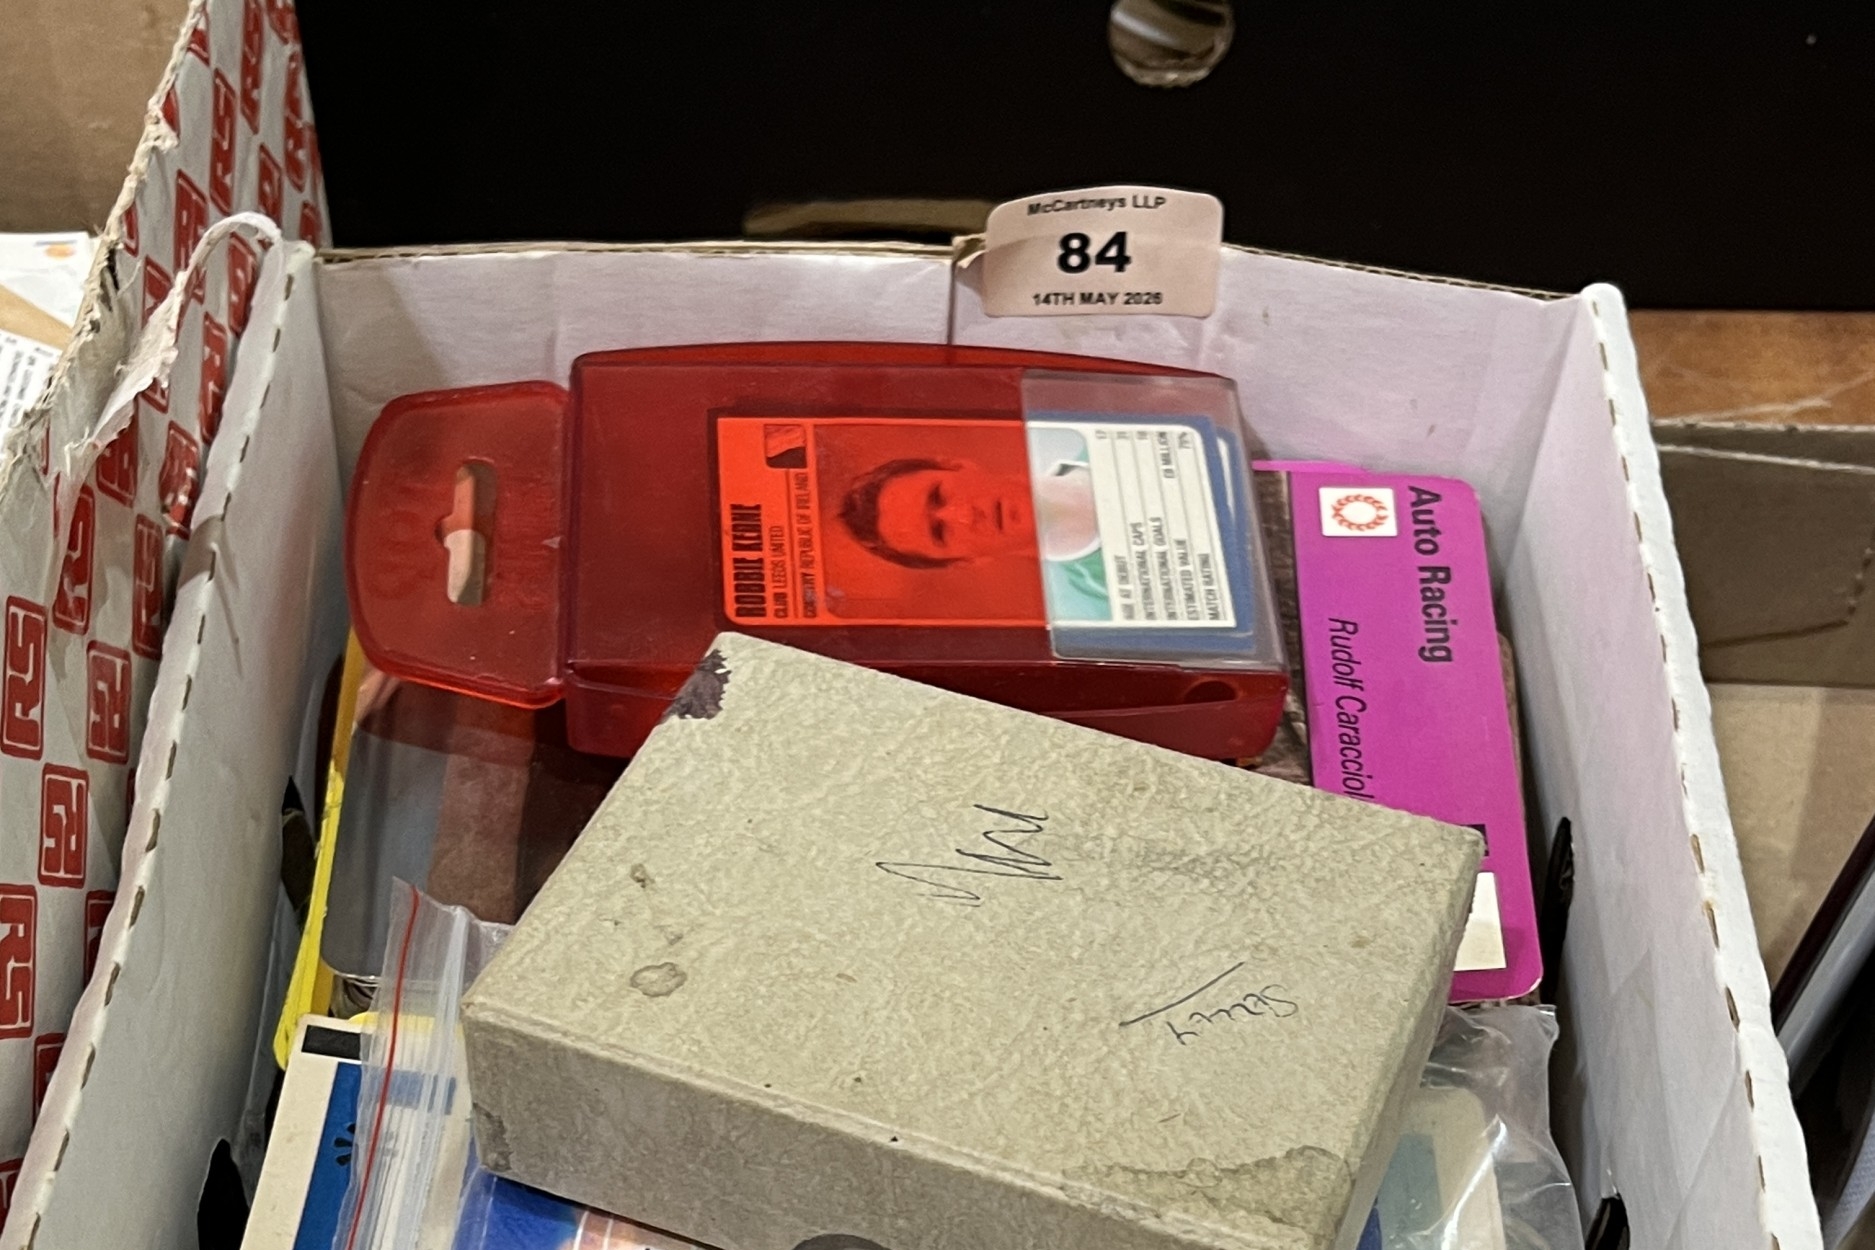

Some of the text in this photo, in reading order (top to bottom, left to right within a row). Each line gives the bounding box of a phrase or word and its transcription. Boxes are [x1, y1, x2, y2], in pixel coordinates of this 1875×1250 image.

[1026, 195, 1167, 215] McCartneys LLP
[1057, 231, 1132, 274] 84
[1032, 292, 1075, 307] 14TH
[1079, 292, 1120, 306] MAY
[1130, 522, 1145, 546] CAPS
[1149, 517, 1166, 547] GOALS
[769, 525, 788, 618] CLUB LEEDS UNITED
[1114, 556, 1130, 585] DEBUT
[1174, 538, 1189, 567] VALUE
[1198, 553, 1215, 587] RATING
[732, 557, 767, 618] ROBBIE
[1136, 551, 1157, 620] INTERNATIONAL
[1156, 551, 1178, 620] INTERNATIONAL
[1408, 485, 1459, 662] Auto Racing
[1119, 588, 1132, 599] AT
[1180, 569, 1199, 620] ESTIMATED
[1204, 588, 1220, 620] MATCH
[1328, 617, 1365, 692] Rudolf
[3, 597, 47, 760] RS
